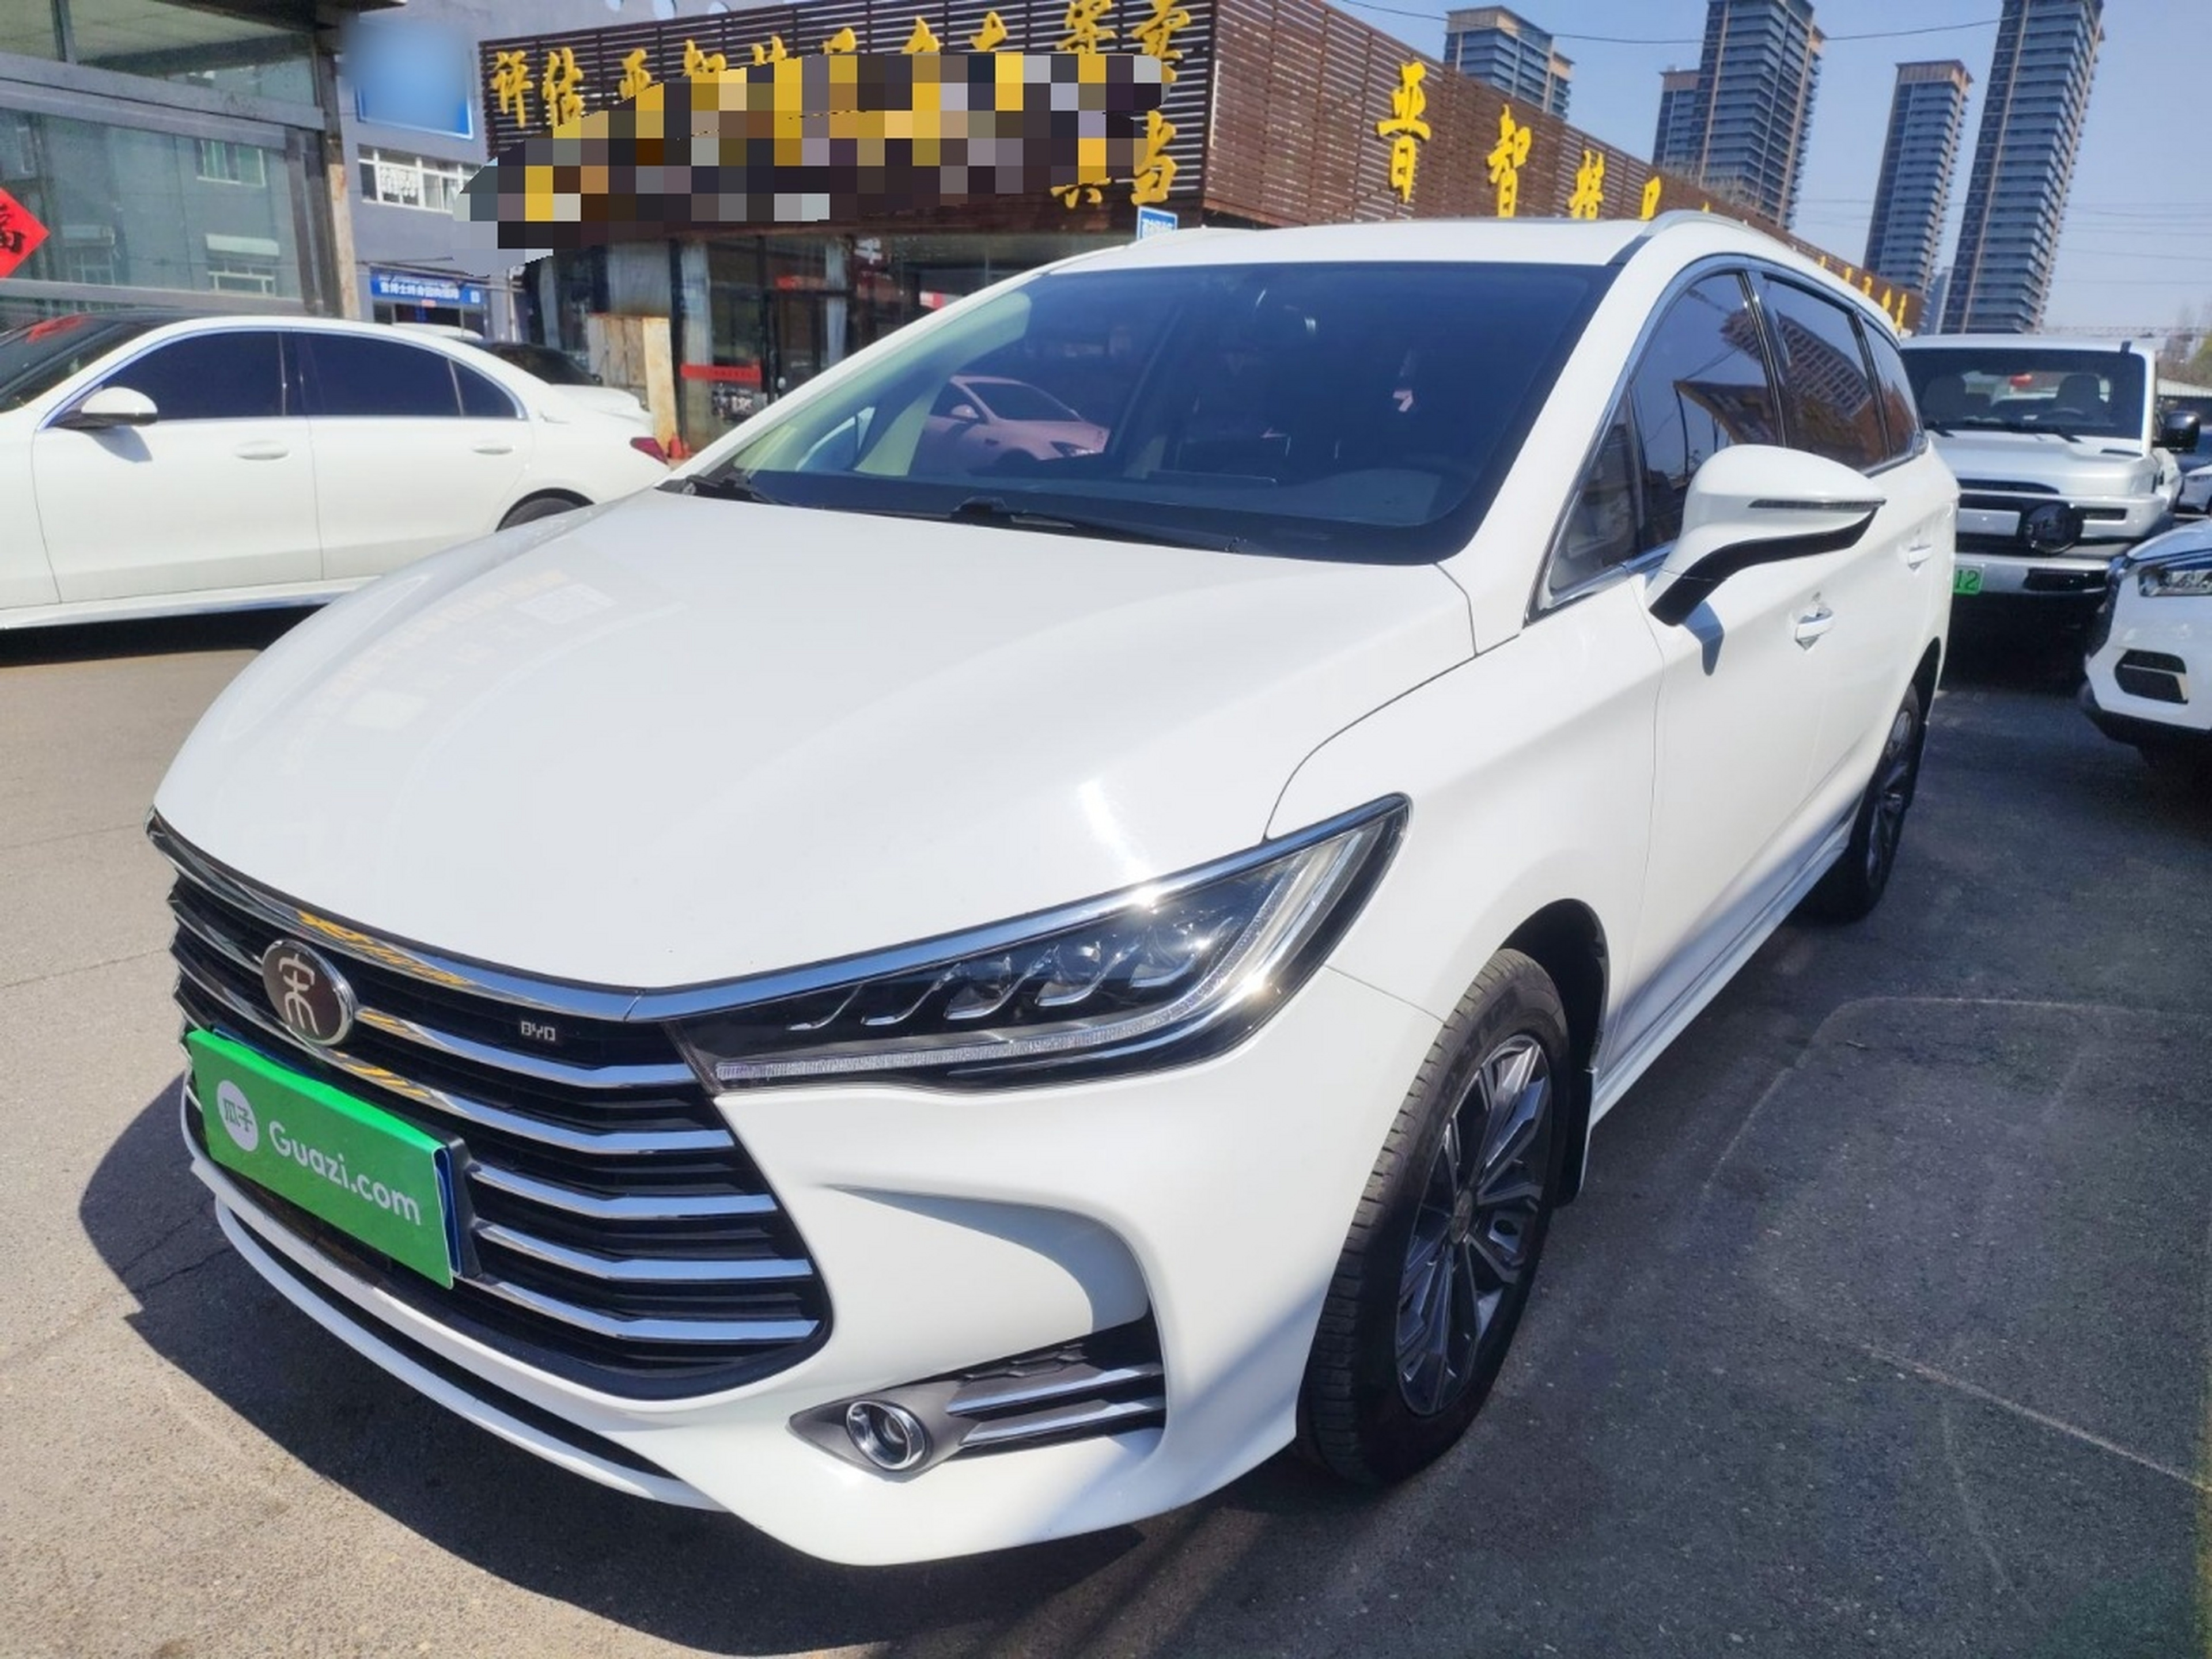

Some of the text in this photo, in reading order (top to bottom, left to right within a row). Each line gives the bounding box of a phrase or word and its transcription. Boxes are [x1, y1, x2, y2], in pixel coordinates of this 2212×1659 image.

[1956, 569, 1979, 590] 12
[521, 1021, 555, 1041] BYD
[223, 1098, 254, 1132] 瓜子
[269, 1120, 421, 1226] Guazi.com
